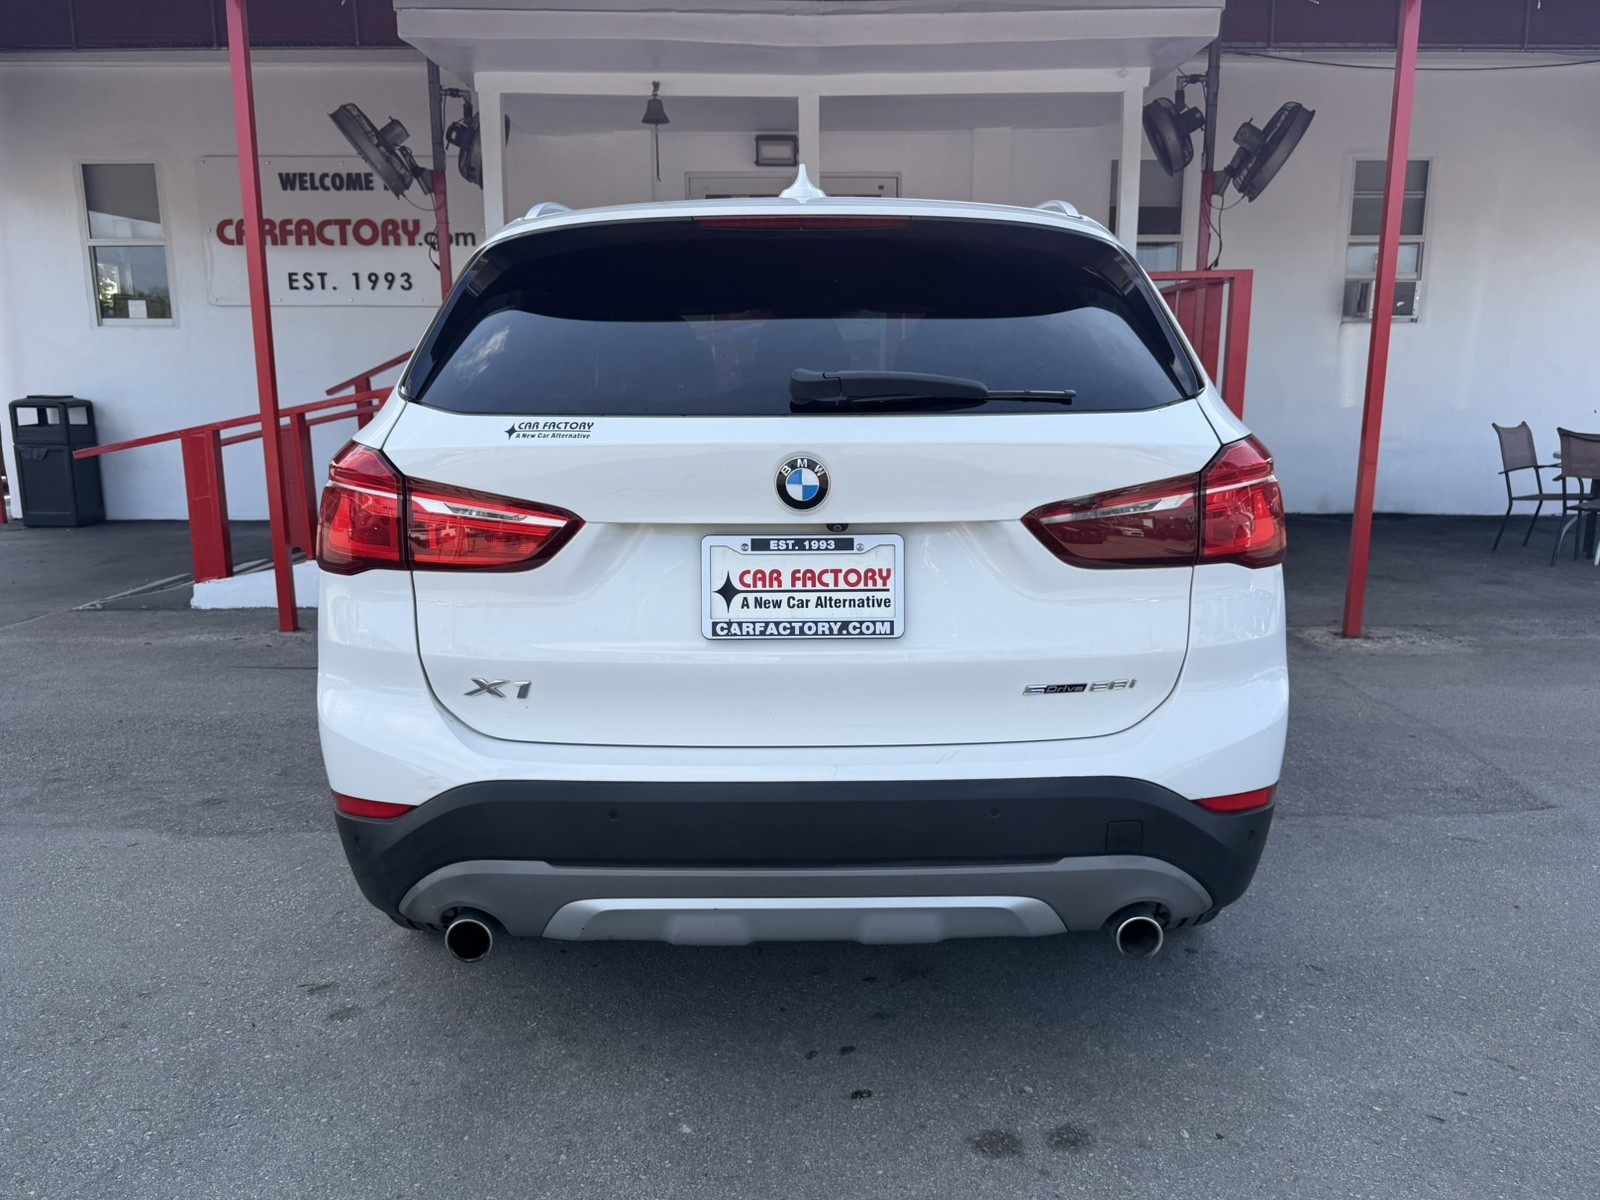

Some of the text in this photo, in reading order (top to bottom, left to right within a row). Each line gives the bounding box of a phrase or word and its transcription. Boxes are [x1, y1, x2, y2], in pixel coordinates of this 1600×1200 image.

[278, 172, 374, 191] WELCOME
[288, 272, 413, 290] EST. 1993
[542, 422, 594, 430] FACTORY
[781, 459, 825, 477] BMW
[769, 540, 836, 550] EST. 1993
[738, 568, 892, 588] CAR FACTORY
[740, 595, 892, 609] A New Car Alternative
[716, 622, 891, 636] CARFACTORY.COM
[463, 678, 532, 699] X1
